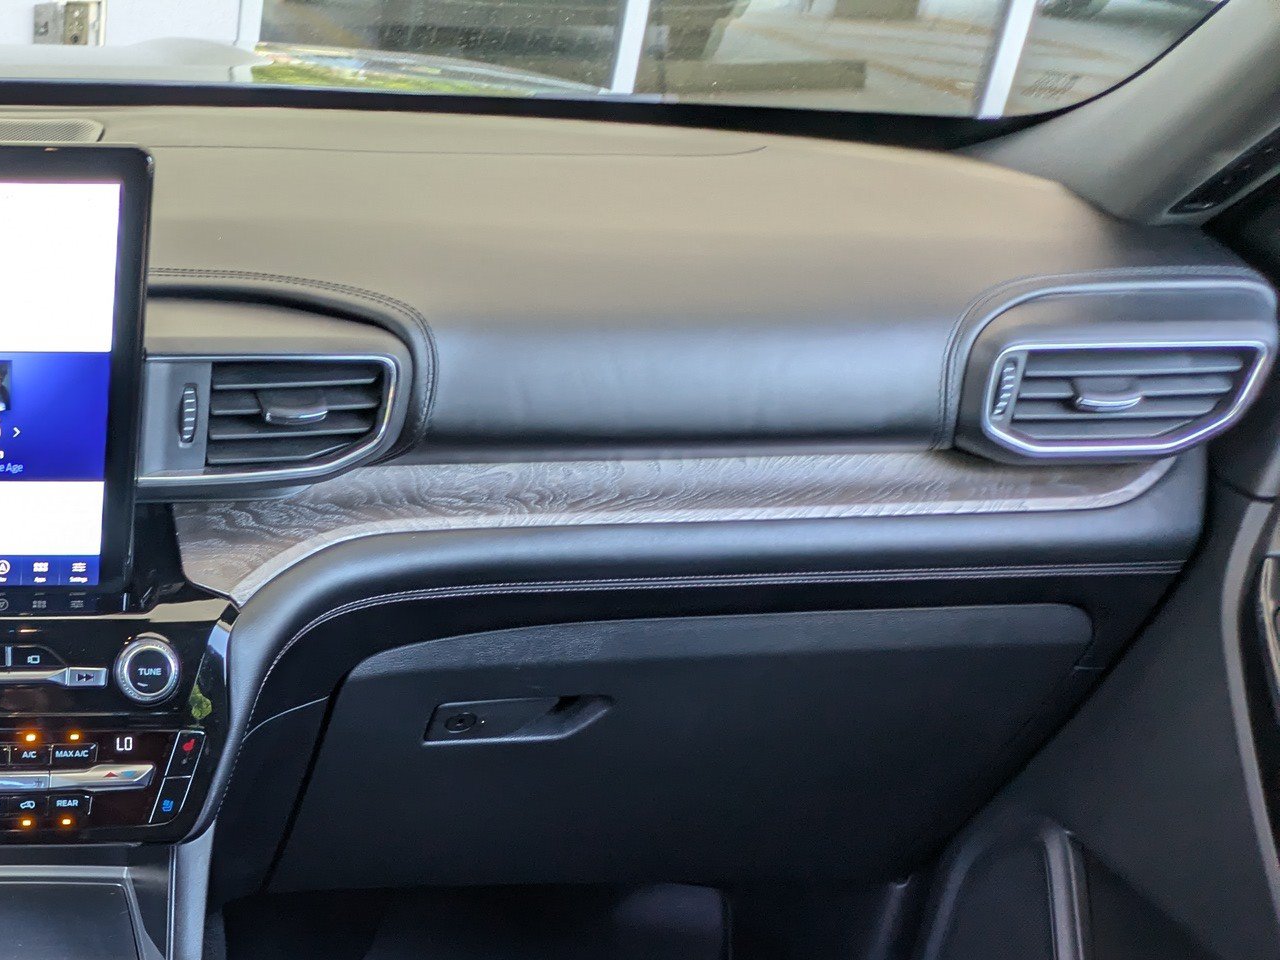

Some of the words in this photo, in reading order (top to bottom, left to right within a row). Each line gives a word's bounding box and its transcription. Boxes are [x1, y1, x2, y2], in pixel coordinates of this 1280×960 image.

[5, 462, 24, 474] Age
[138, 668, 163, 676] TUNE
[116, 736, 134, 751] LO
[22, 751, 37, 759] A/C
[55, 750, 74, 758] MAX
[74, 749, 89, 758] A/C
[56, 800, 79, 808] REAR
